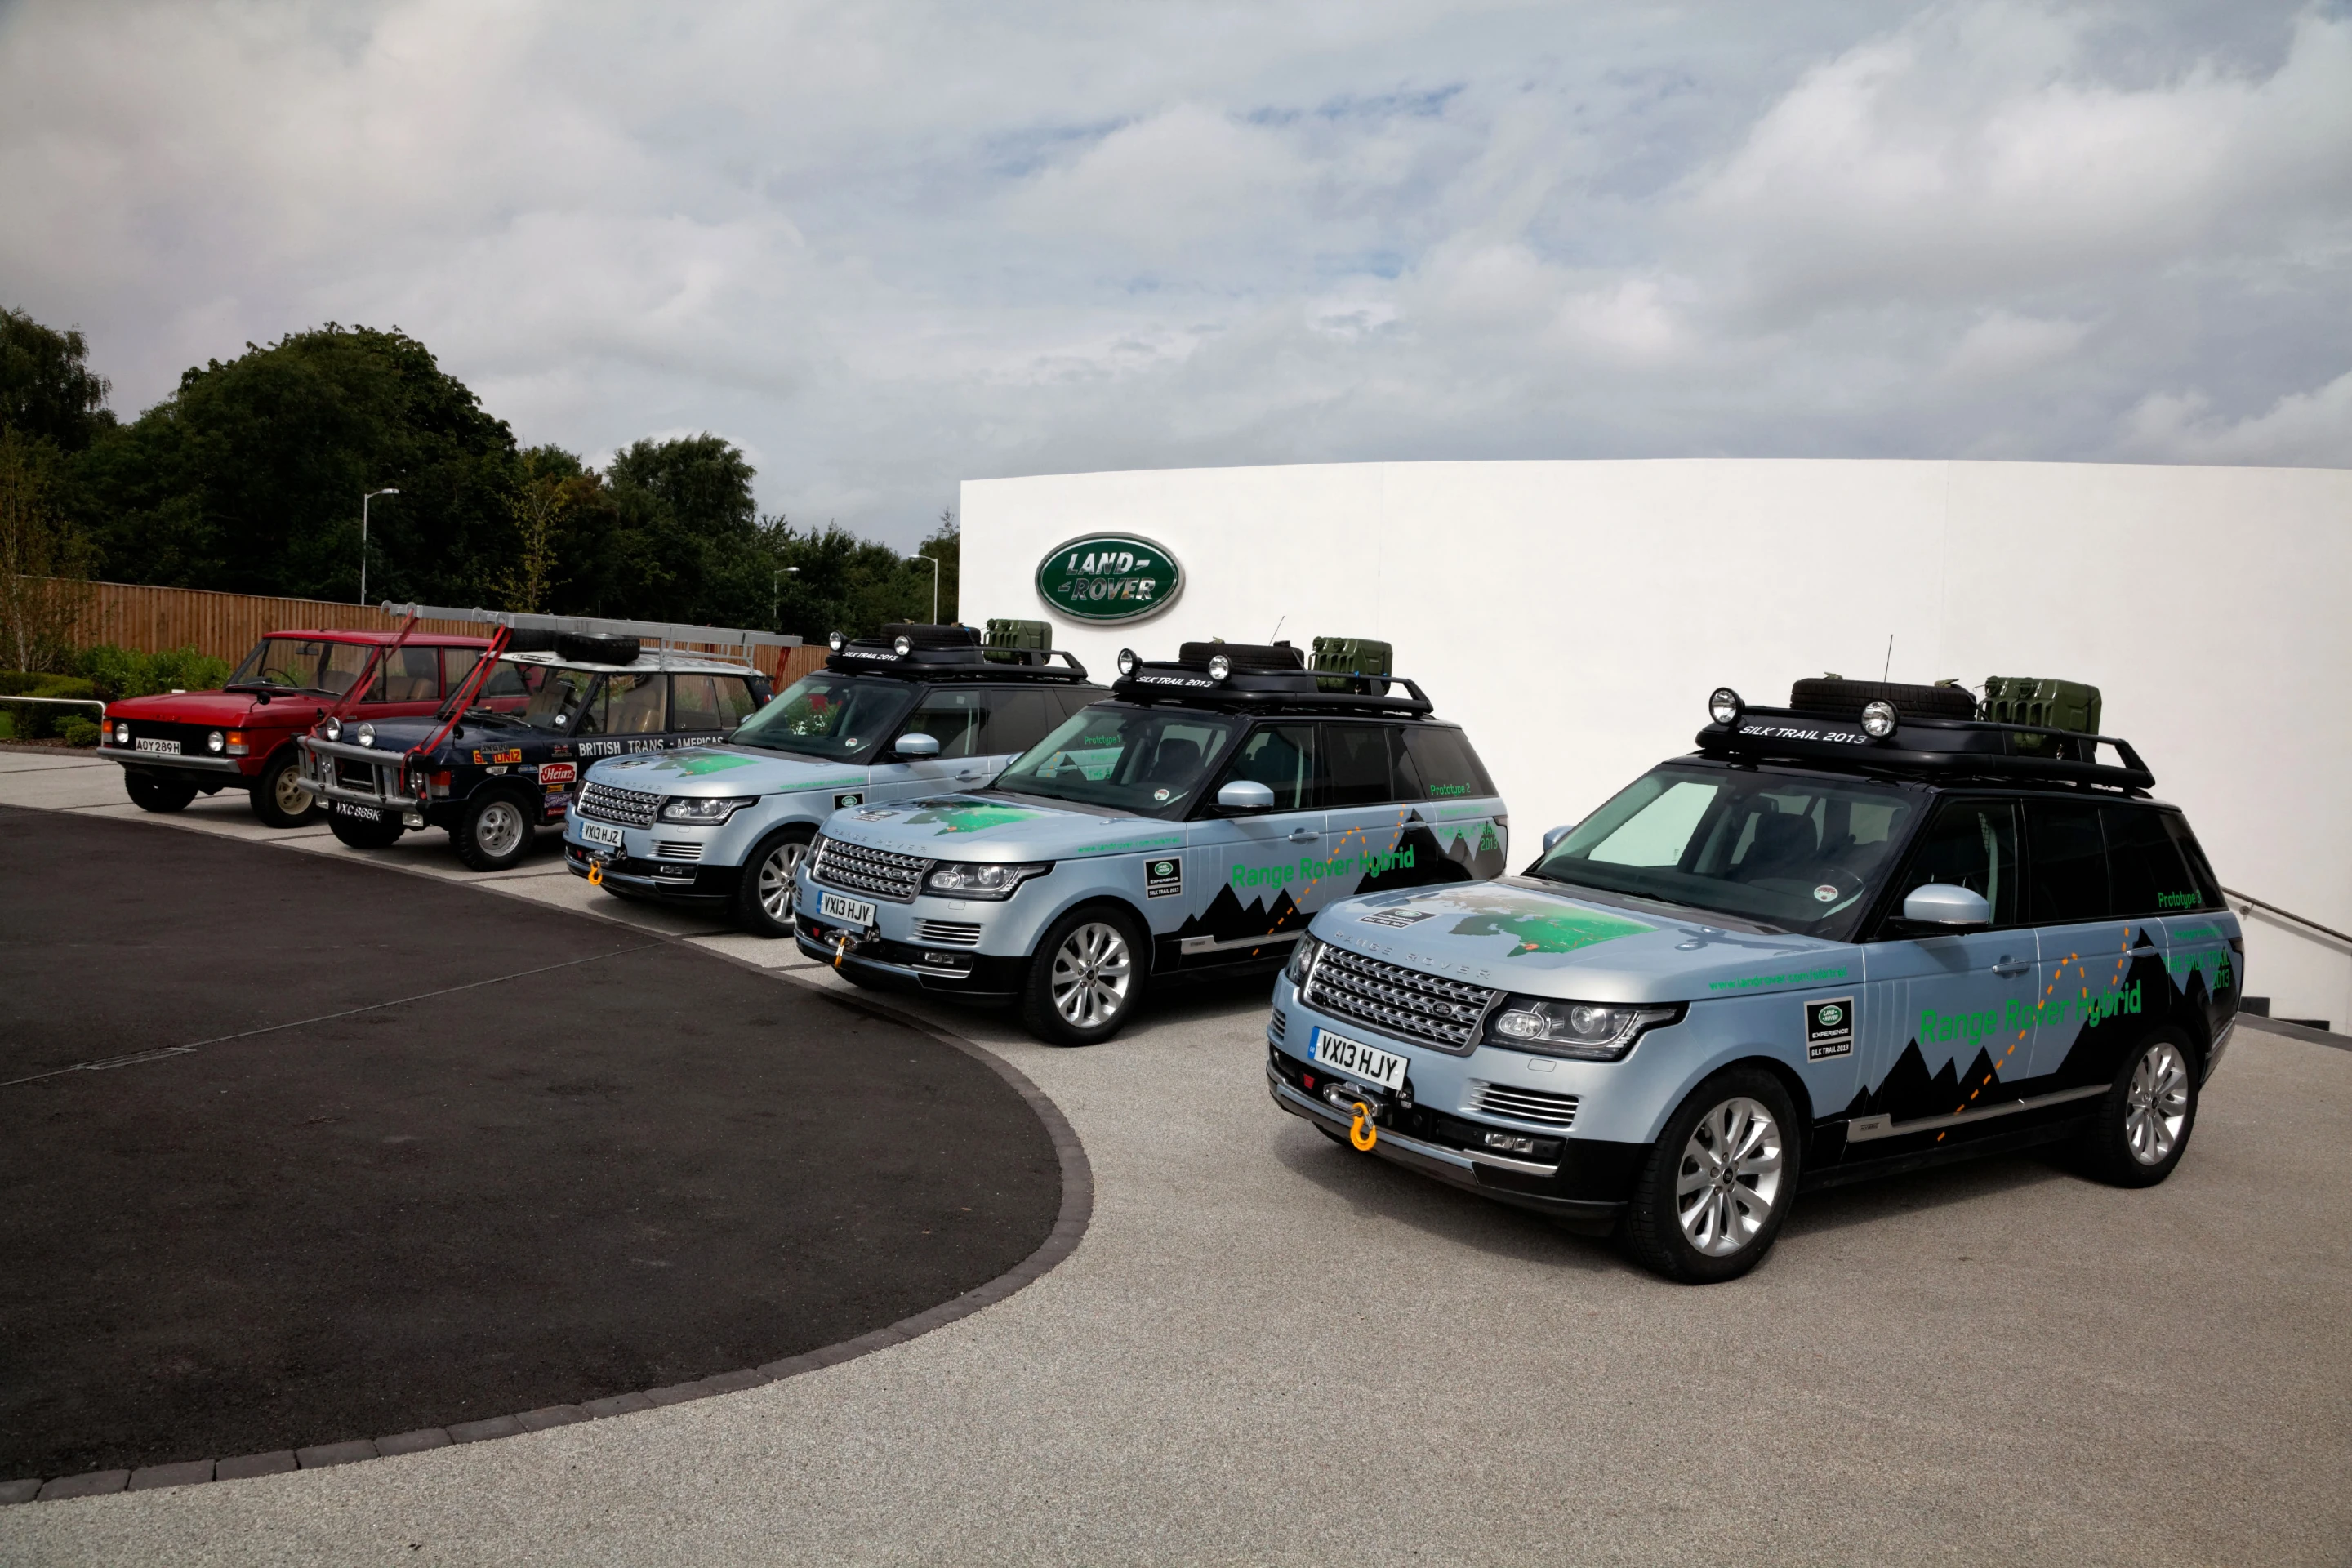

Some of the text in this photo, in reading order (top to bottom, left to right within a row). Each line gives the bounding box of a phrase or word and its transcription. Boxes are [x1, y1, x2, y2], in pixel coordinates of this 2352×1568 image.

[1156, 677, 1185, 686] TRAIL
[1185, 679, 1214, 688] 2013
[1084, 735, 1116, 746] Prototype
[1740, 726, 1868, 744] SILK TRAIL 2013
[155, 742, 180, 753] 289H
[578, 741, 621, 757] BRITISH
[627, 738, 664, 753] TRANS
[541, 768, 574, 782] Heinz
[1430, 782, 1471, 796] Prototype 2
[336, 802, 380, 821] VXC 868K
[585, 824, 619, 844] VX13 HJZ
[1481, 836, 1499, 851] 2013
[1232, 844, 1414, 889] Range Rover Hybrid
[825, 895, 870, 922] VX13 HJV
[2158, 889, 2203, 909] Prototype 3
[1334, 930, 1491, 980] RANGE ROVER
[2163, 948, 2230, 975] THE SILK TRAIL
[1708, 965, 1849, 991] www.landrover.com/silktrail
[2211, 969, 2230, 990] 2013
[1920, 979, 2141, 1045] Range Rover Hybrid
[1811, 1028, 1849, 1039] EXPERIENCE
[1322, 1035, 1397, 1082] VX13 HJY
[1811, 1044, 1849, 1056] SILK TRAIL 2013
